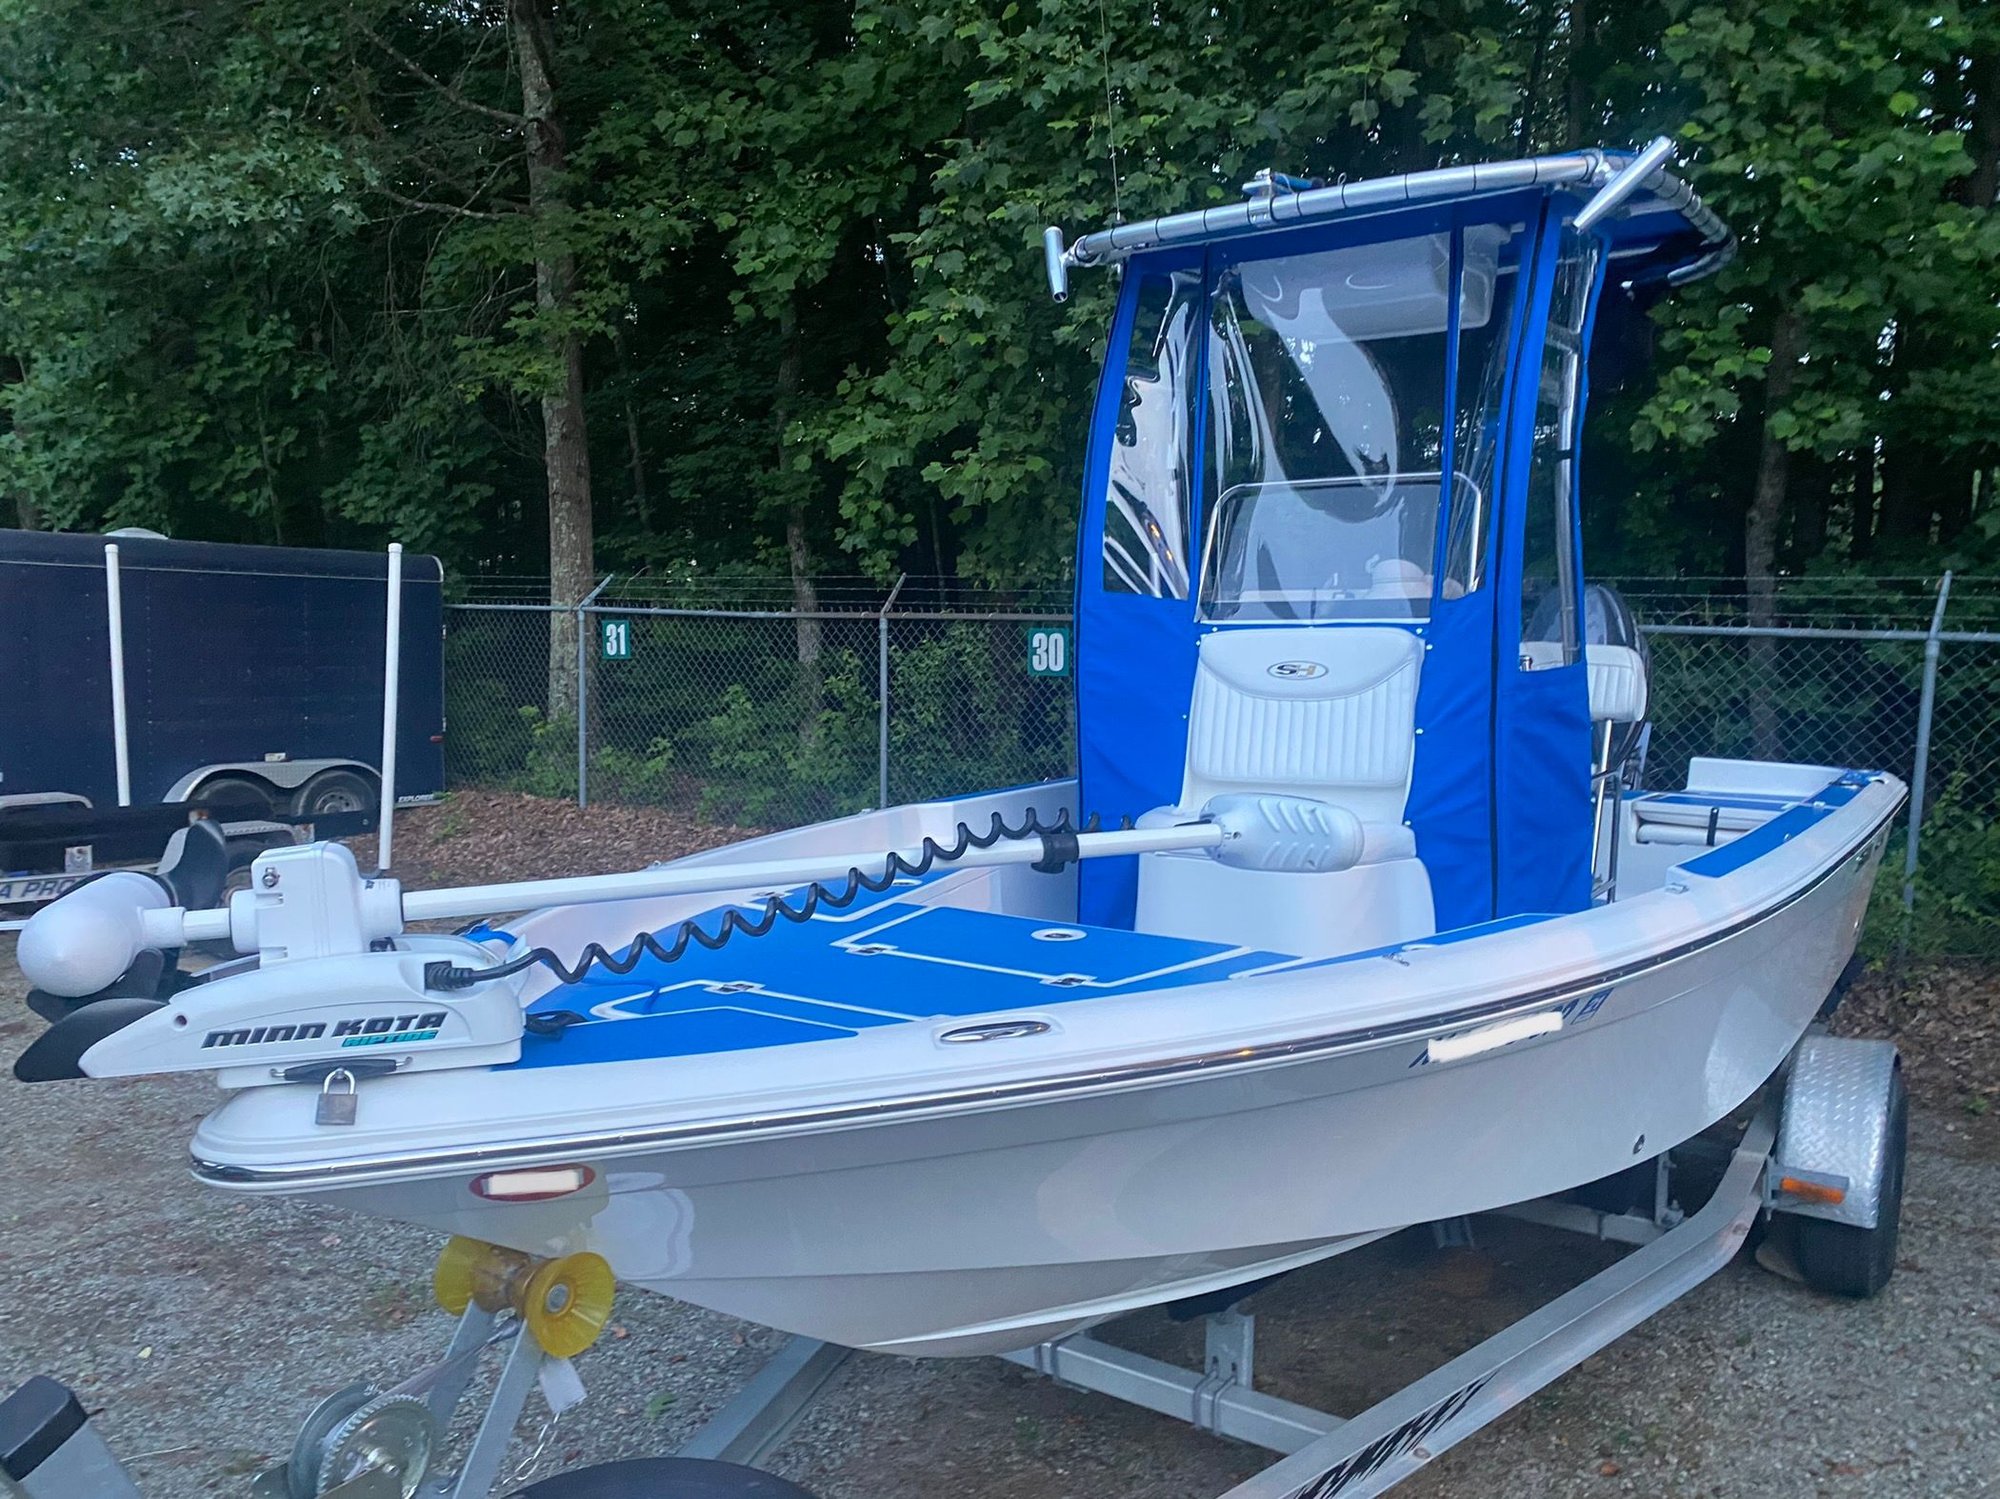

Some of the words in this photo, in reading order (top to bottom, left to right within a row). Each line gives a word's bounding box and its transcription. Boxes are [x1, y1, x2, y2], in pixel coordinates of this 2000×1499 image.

[606, 623, 626, 656] 31
[1032, 632, 1064, 671] 30
[201, 1022, 327, 1049] MINN
[331, 1011, 449, 1037] KOTA
[341, 1029, 440, 1048] RIPTIDE
